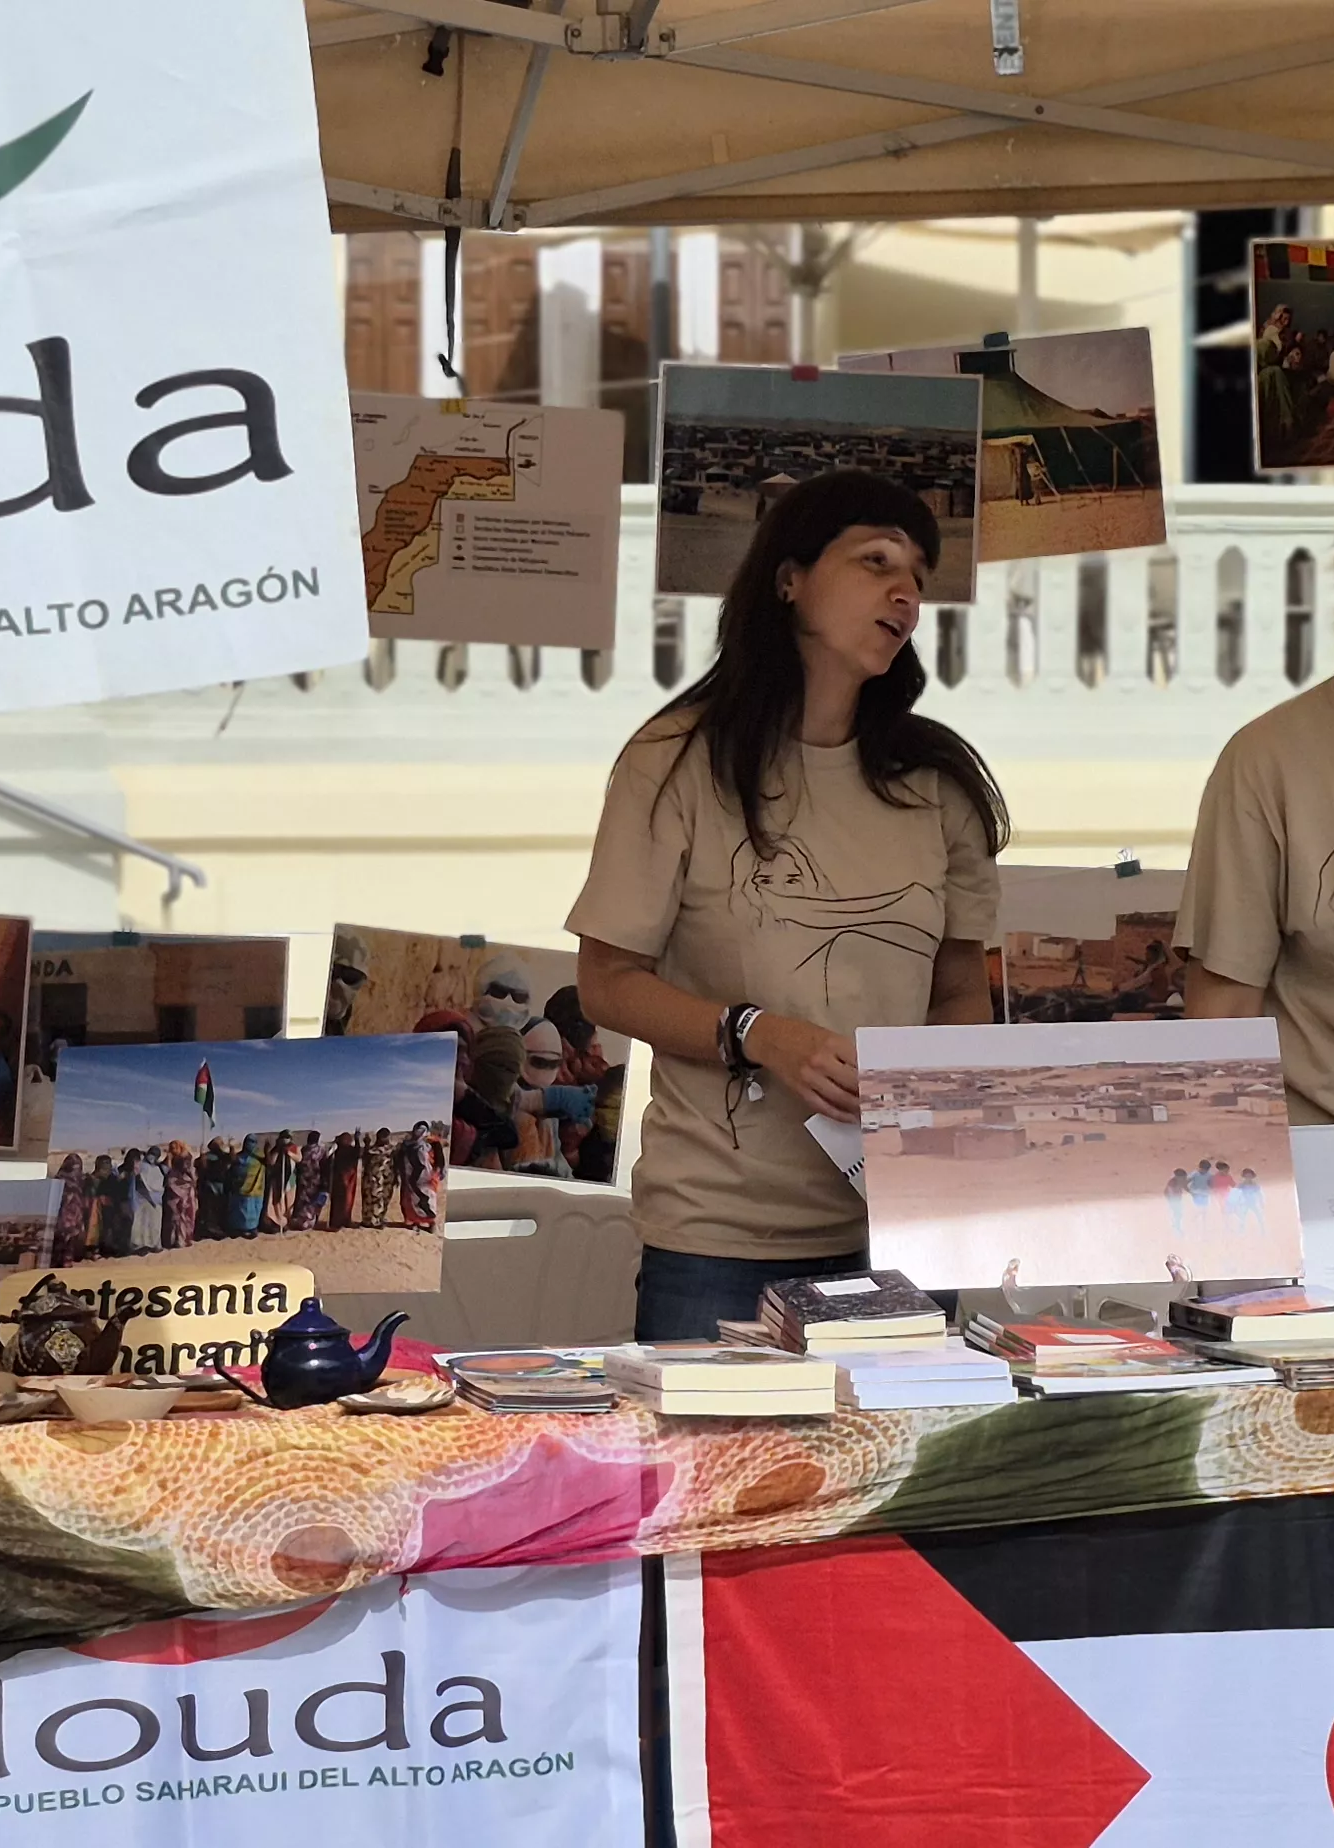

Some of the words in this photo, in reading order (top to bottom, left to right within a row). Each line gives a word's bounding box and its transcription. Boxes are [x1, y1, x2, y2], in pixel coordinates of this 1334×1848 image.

[123, 566, 321, 625] ARAGÓN
[135, 1771, 288, 1802] SAHARAUI
[298, 1766, 360, 1790] DEL
[367, 1765, 446, 1787] ALTO
[451, 1751, 575, 1784] ARAGÓN
